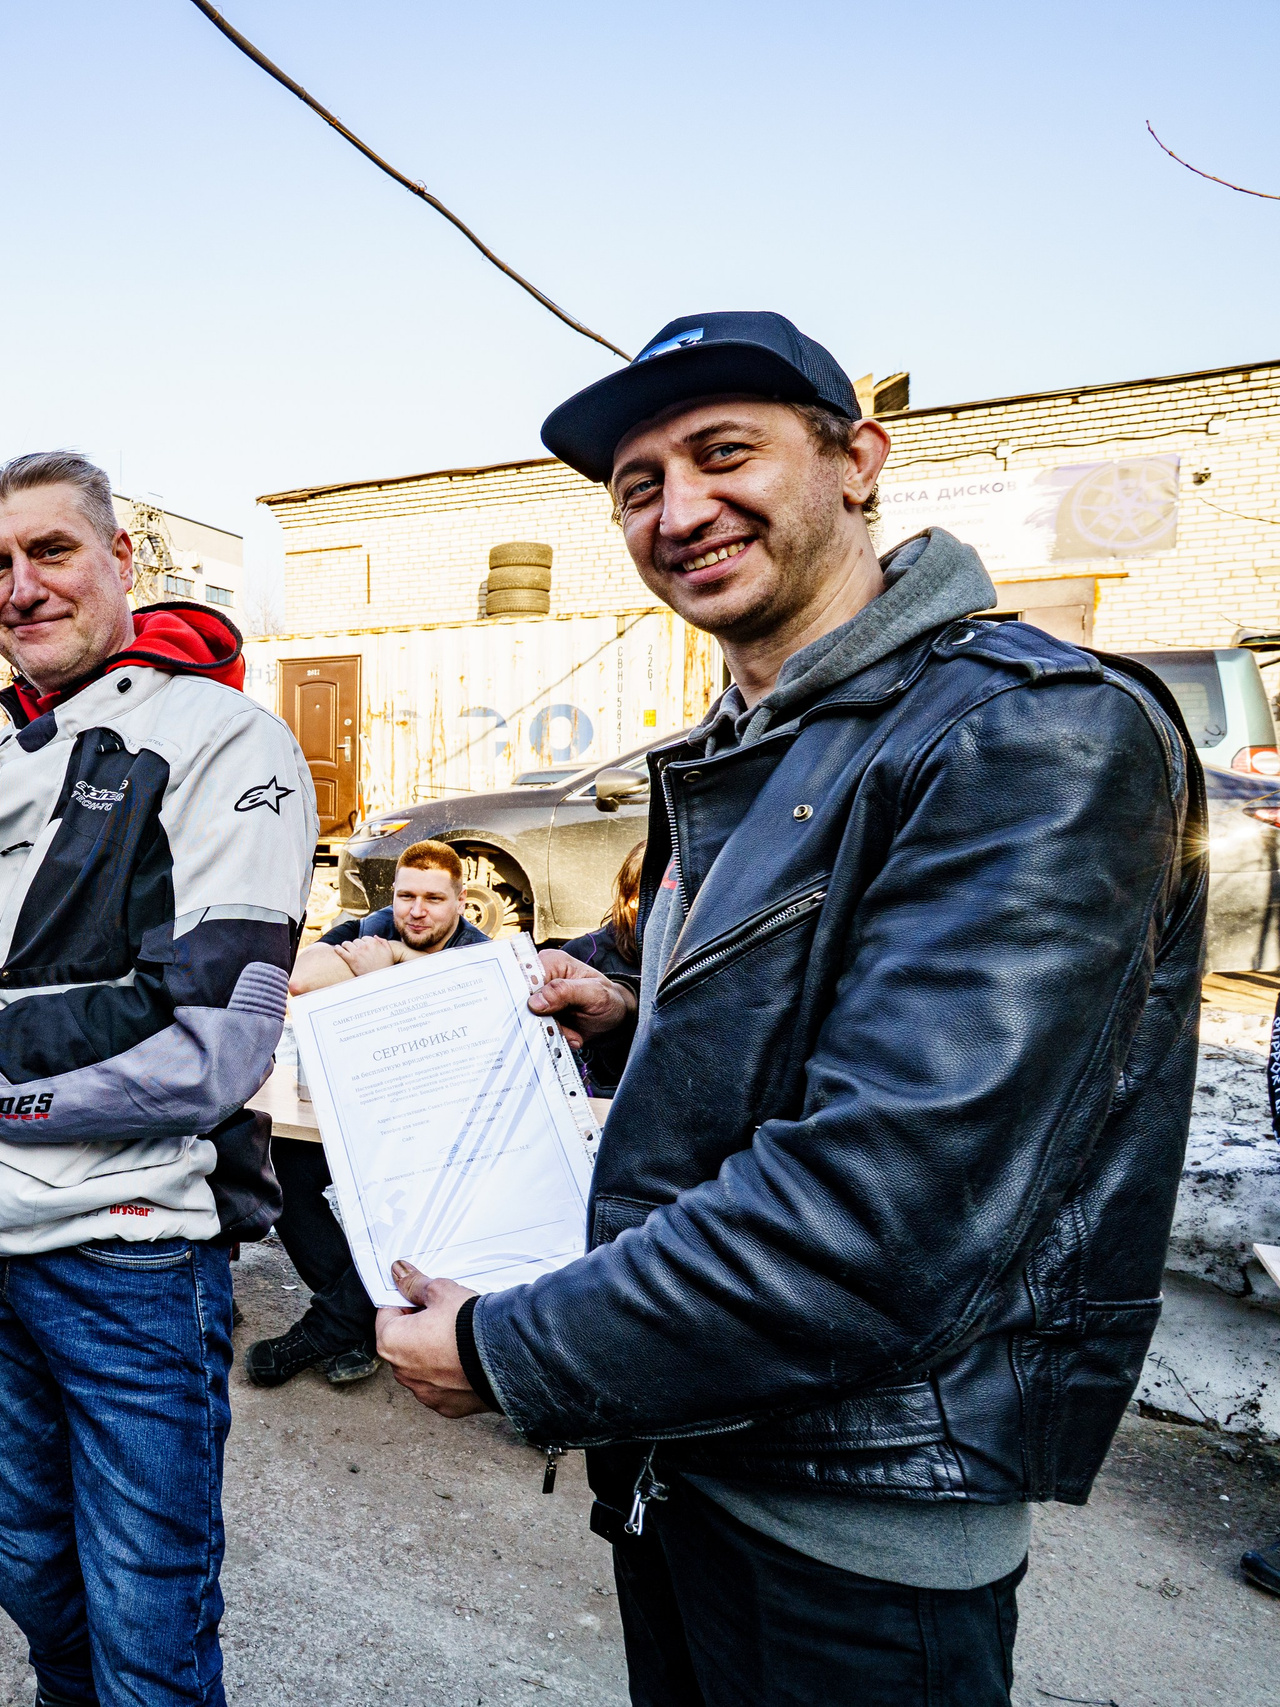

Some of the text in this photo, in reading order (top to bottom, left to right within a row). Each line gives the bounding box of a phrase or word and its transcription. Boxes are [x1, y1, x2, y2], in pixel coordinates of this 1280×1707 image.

[937, 481, 1017, 501] ДИСКОВ
[332, 978, 483, 1025] САНКТ-ПЕТЕРБУРГСКАЯ ГОРОДСКАЯ КОЛЛЕГИЯ
[360, 1063, 400, 1077] бесплатную
[402, 1049, 449, 1066] юридическую
[450, 1037, 499, 1052] консультацию
[372, 1026, 467, 1060] СЕРТИФИКАТ
